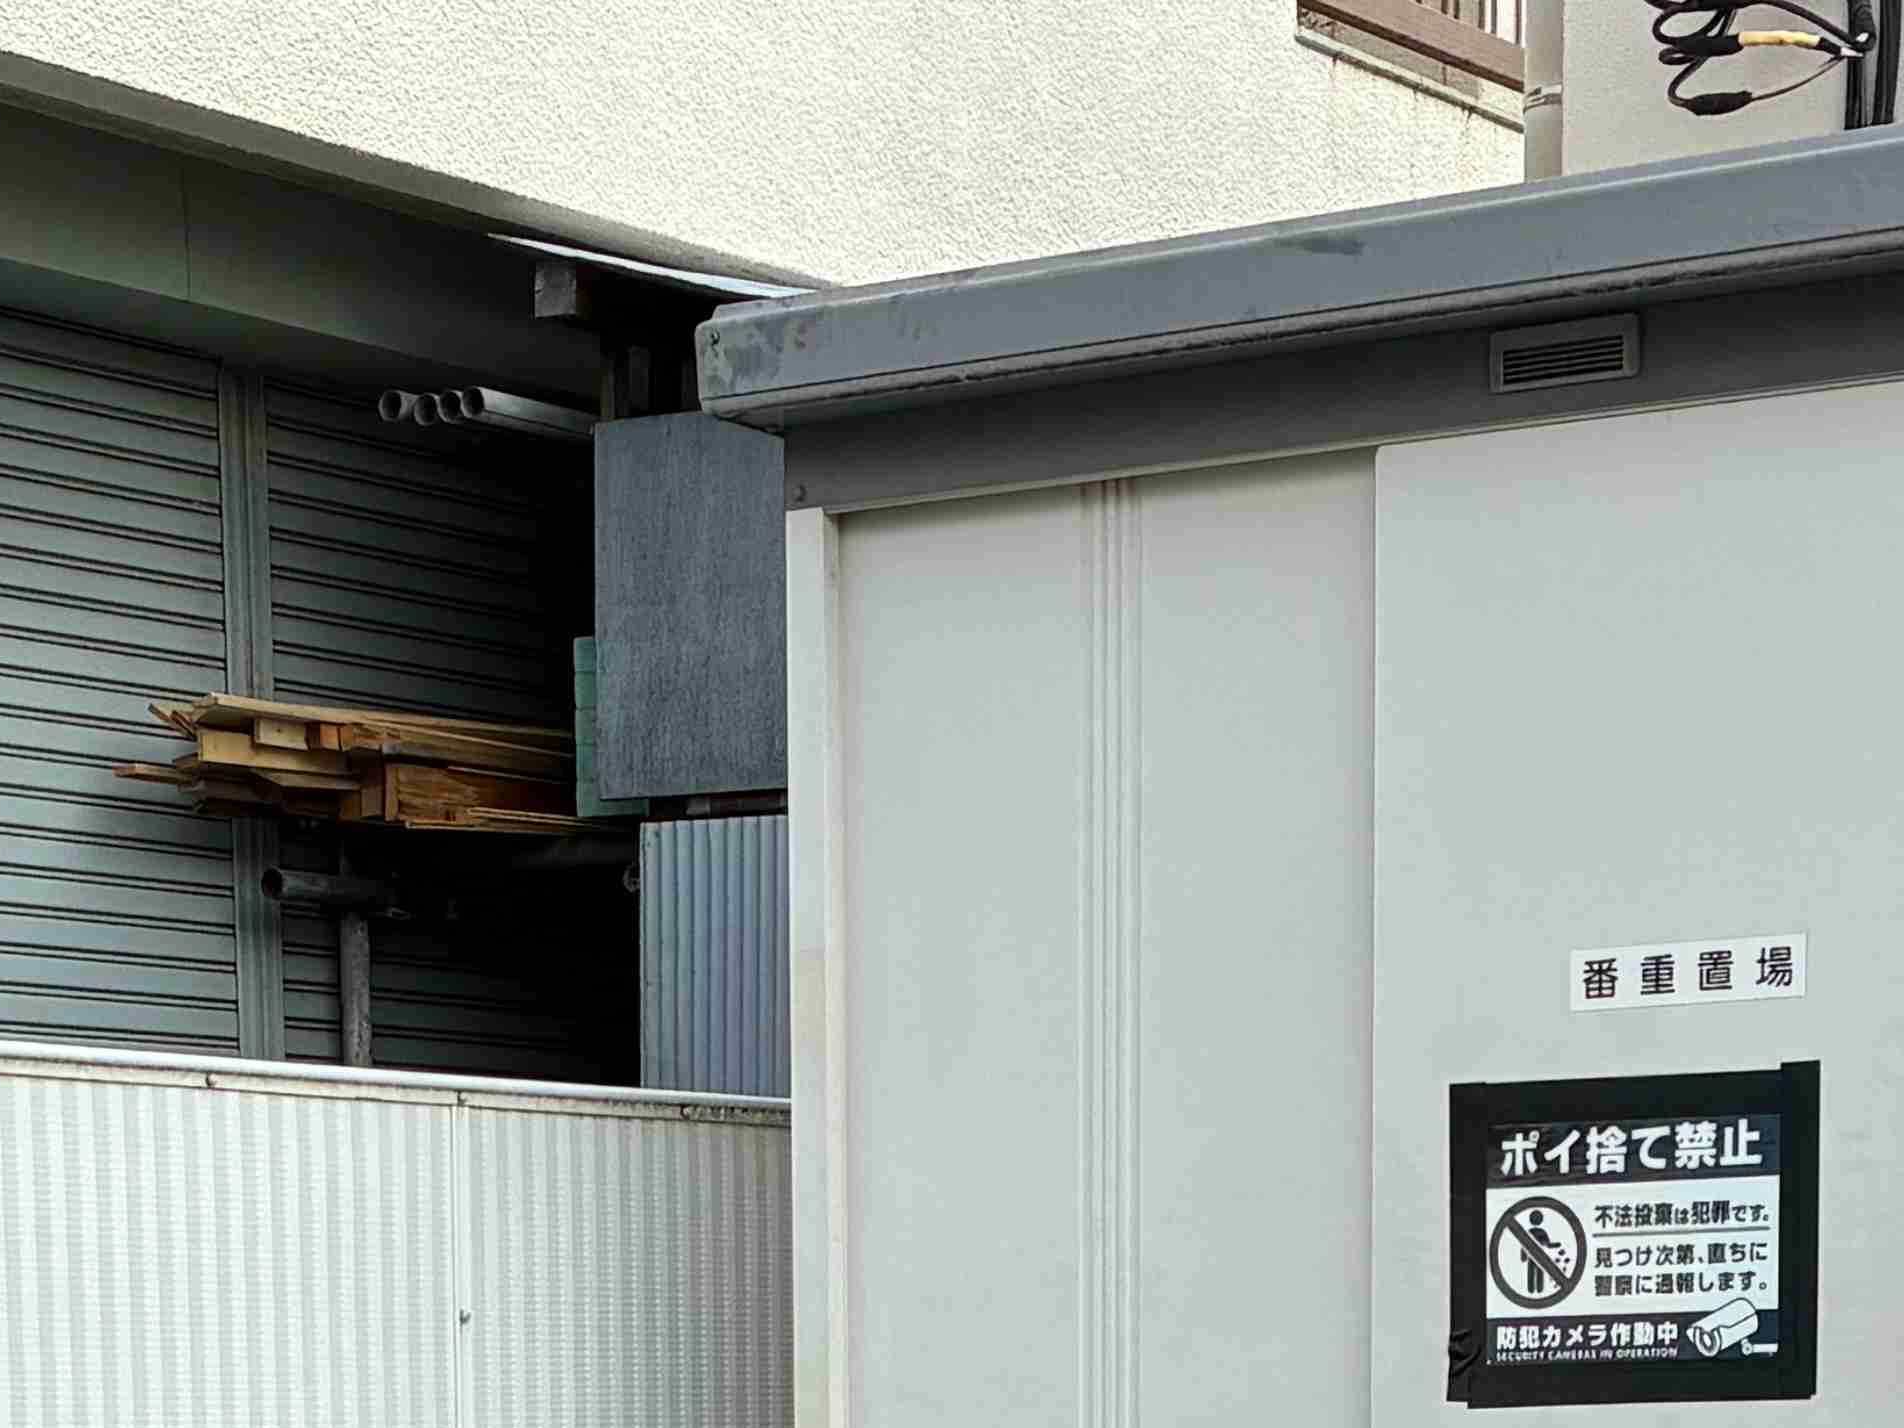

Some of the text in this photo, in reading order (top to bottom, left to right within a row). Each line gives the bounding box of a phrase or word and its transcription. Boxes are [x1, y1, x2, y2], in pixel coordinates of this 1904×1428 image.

[1582, 947, 1795, 999] 番重置場
[1500, 1118, 1764, 1177] ポイ捨て禁止
[1593, 1200, 1770, 1229] 不法投棄は犯罪です。
[1593, 1241, 1769, 1269] 見つけ次第、直ちに
[1593, 1271, 1768, 1297] 警察に通報します。
[1496, 1320, 1679, 1350] 防犯カメラ作動中
[1496, 1349, 1546, 1362] SECURITY
[1616, 1346, 1678, 1360] OPERATION
